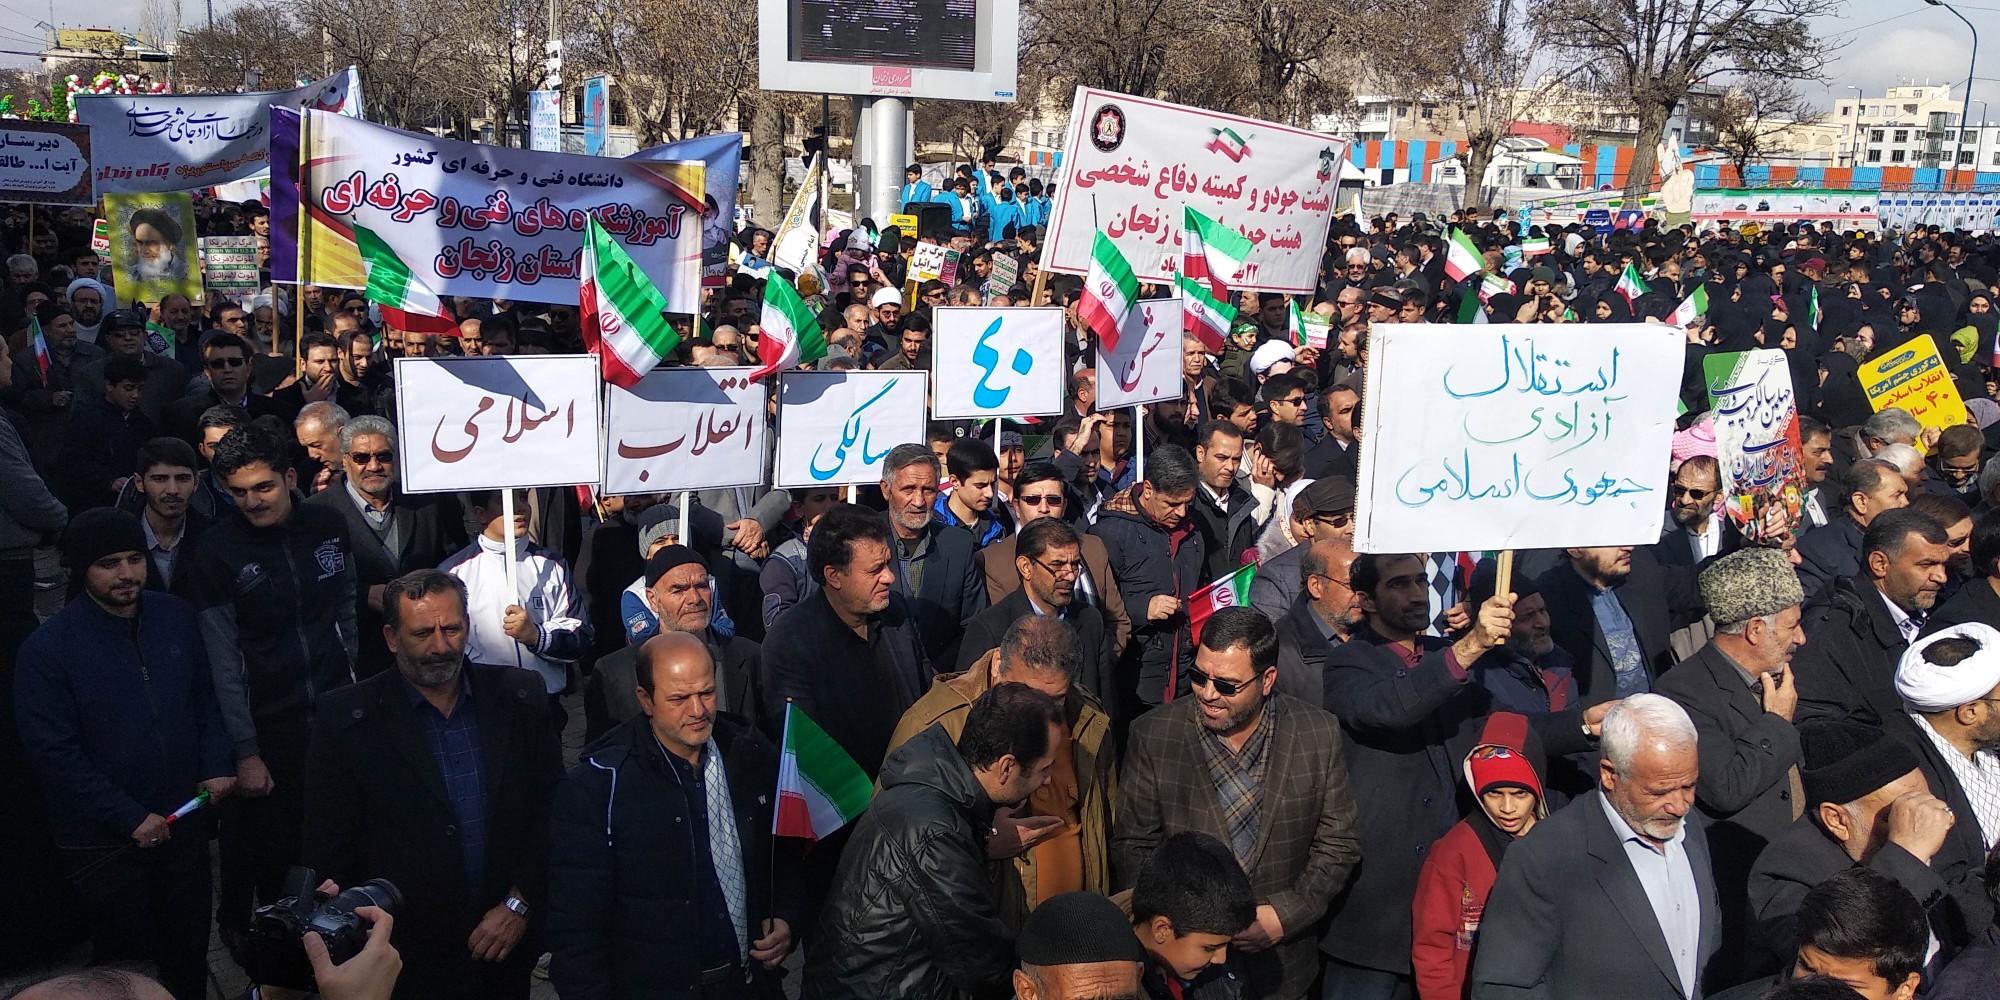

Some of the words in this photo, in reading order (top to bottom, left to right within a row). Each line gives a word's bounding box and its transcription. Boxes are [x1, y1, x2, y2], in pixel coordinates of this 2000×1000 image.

[872, 71, 889, 84] زنجان
[889, 69, 911, 84] شهرداری
[168, 122, 197, 144] جای
[52, 158, 77, 175] آیت
[391, 148, 438, 167] کشور
[441, 157, 467, 174] ای
[135, 162, 171, 181] پگاه
[470, 161, 514, 182] حرفه
[517, 173, 528, 185] و
[532, 169, 563, 188] فنی
[568, 172, 624, 188] دانشگاه
[1075, 157, 1150, 188] شخصی
[1154, 163, 1198, 199] دفاع
[322, 170, 367, 215] ای
[366, 173, 439, 222] حرفه
[1202, 175, 1248, 205] کمیته
[1247, 188, 1258, 211] و
[1259, 185, 1299, 215] جودو
[436, 197, 460, 227] و
[460, 188, 514, 229] فنی
[1301, 187, 1330, 218] هیئت
[513, 198, 567, 235] های
[1107, 204, 1170, 244] زنجان
[239, 239, 252, 247] مرگ
[807, 235, 816, 249] امام
[918, 247, 928, 256] بر
[1270, 224, 1302, 256] هیئت
[235, 255, 254, 263] الموت
[434, 237, 516, 282] زنجان
[516, 245, 583, 284] استان
[913, 258, 941, 271] اسرائیل
[929, 248, 944, 258] مرگ
[238, 272, 256, 280] الموت
[1121, 305, 1167, 397] جشن
[1930, 357, 1939, 365] به
[1443, 334, 1620, 400] استقلال
[1893, 371, 1910, 386] چشم
[1910, 361, 1929, 377] کوری
[1869, 378, 1892, 395] آمریکا
[1913, 370, 1945, 393] انقلاب
[1926, 391, 1949, 409] ۴۰
[431, 391, 575, 463] اسلامی
[617, 376, 754, 483] انقلاب
[809, 377, 900, 481] سالگی
[1464, 396, 1628, 461] آزادی
[1396, 447, 1521, 509] اسلامی
[1524, 467, 1654, 510] جمهوری
